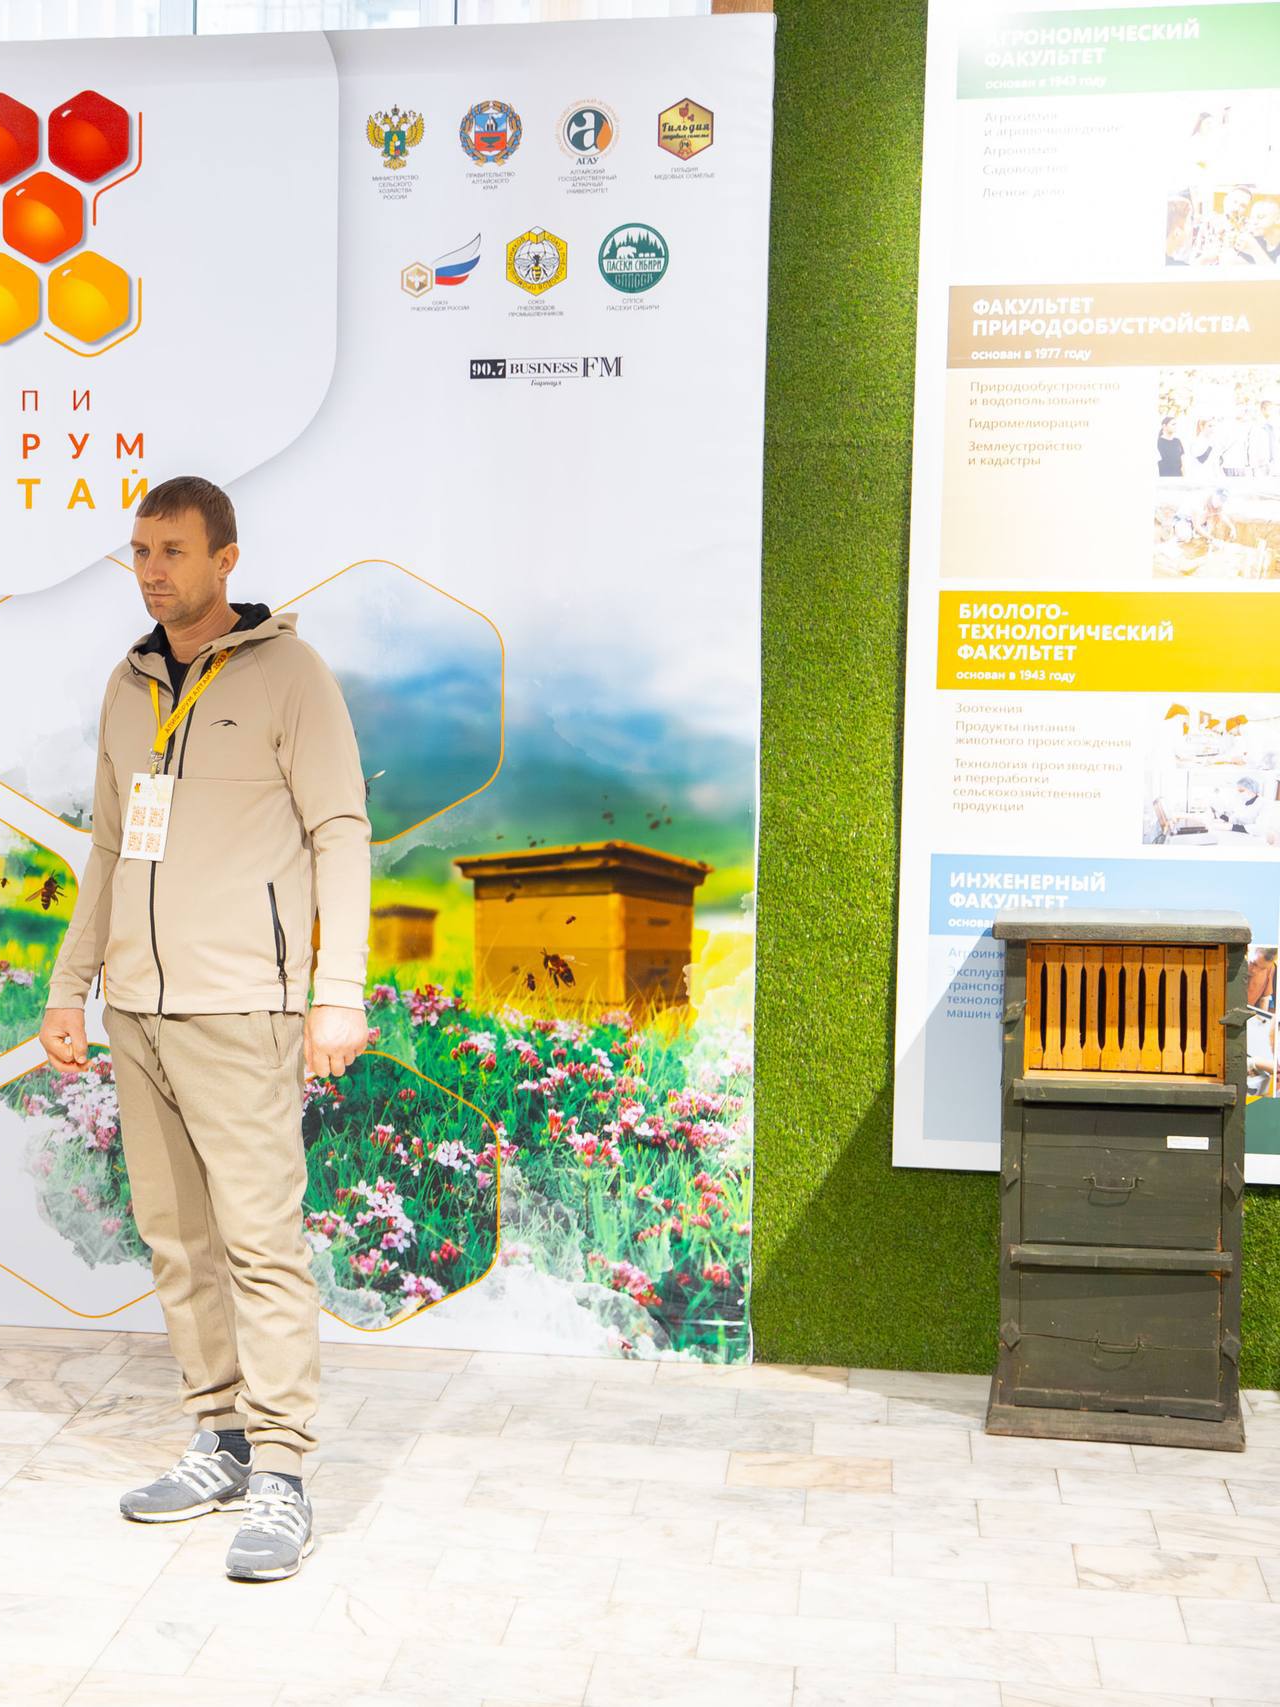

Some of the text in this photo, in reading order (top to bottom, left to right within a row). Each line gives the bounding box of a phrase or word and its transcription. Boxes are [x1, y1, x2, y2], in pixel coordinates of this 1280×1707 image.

[985, 18, 1200, 46] АГРОНОМИЧЕСКИЙ
[984, 47, 1105, 67] ФАКУЛЬТЕТ
[985, 78, 1036, 90] основан
[1078, 76, 1106, 90] году
[607, 260, 662, 271] ПАСЕКИ СИБИРИ
[972, 297, 1094, 315] ФАКУЛЬТЕТ
[972, 312, 1250, 338] ПРИРОДООБУСТРОЙСТВА
[971, 350, 1021, 360] основан
[1035, 348, 1060, 359] 1977
[1064, 349, 1092, 362] году
[471, 356, 623, 377] 90.7 BUSINESS FM
[959, 603, 1069, 620] БИОЛОГО-
[958, 621, 1174, 641] ТЕХНОЛОГИЧЕСКИЙ
[957, 644, 1077, 662] ФАКУЛЬТЕТ
[956, 669, 1076, 683] основан в 1943 году
[955, 703, 1022, 714] Зоотехния
[955, 720, 1018, 735] Продукты
[954, 758, 1028, 770] Технология
[965, 773, 1050, 786] переработки
[952, 801, 1024, 813] продукции
[949, 871, 1106, 891] ИНЖЕНЕРНЫЙ
[948, 893, 1069, 909] ФАКУЛЬТЕТ
[946, 1009, 991, 1020] машин
